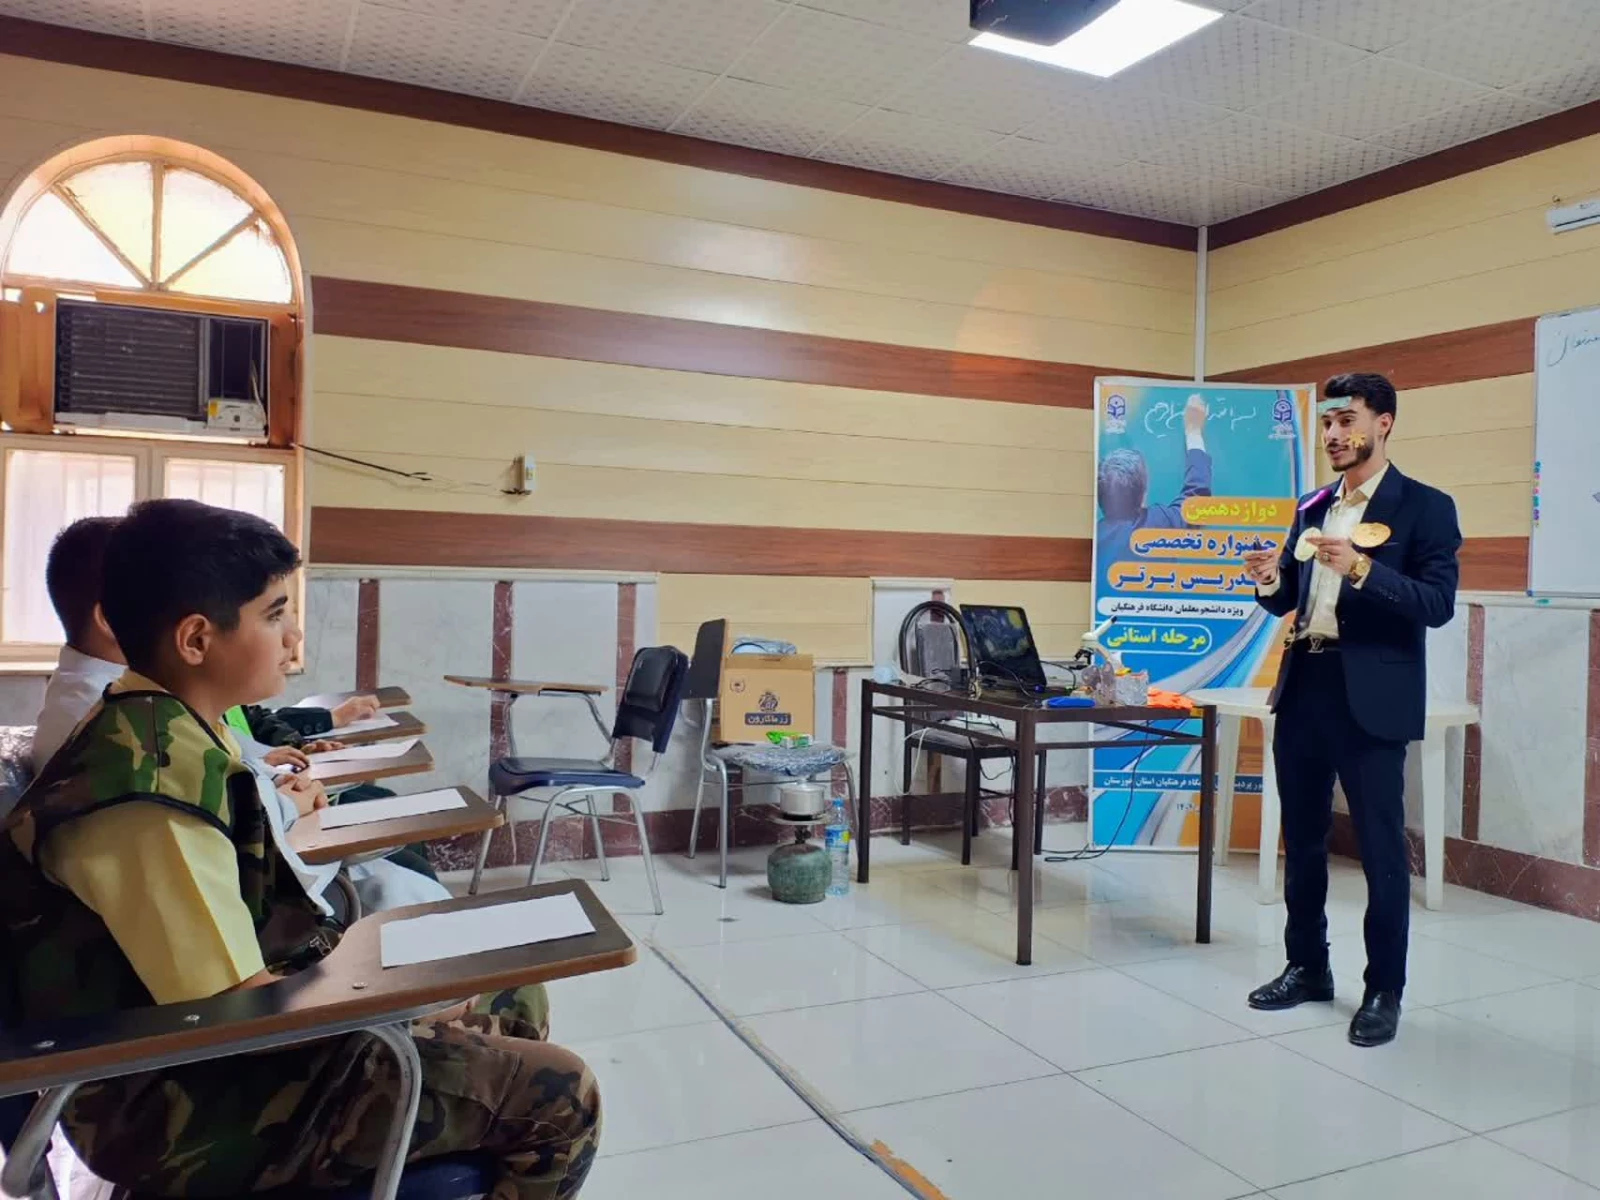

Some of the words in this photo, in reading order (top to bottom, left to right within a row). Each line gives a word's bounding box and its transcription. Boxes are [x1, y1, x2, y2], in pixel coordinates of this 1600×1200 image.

[1185, 502, 1277, 523] دوازدهمین
[1134, 533, 1203, 555] تخصصی
[1181, 573, 1257, 591] دریس
[1106, 626, 1157, 648] استانی
[1160, 627, 1207, 650] مرحله
